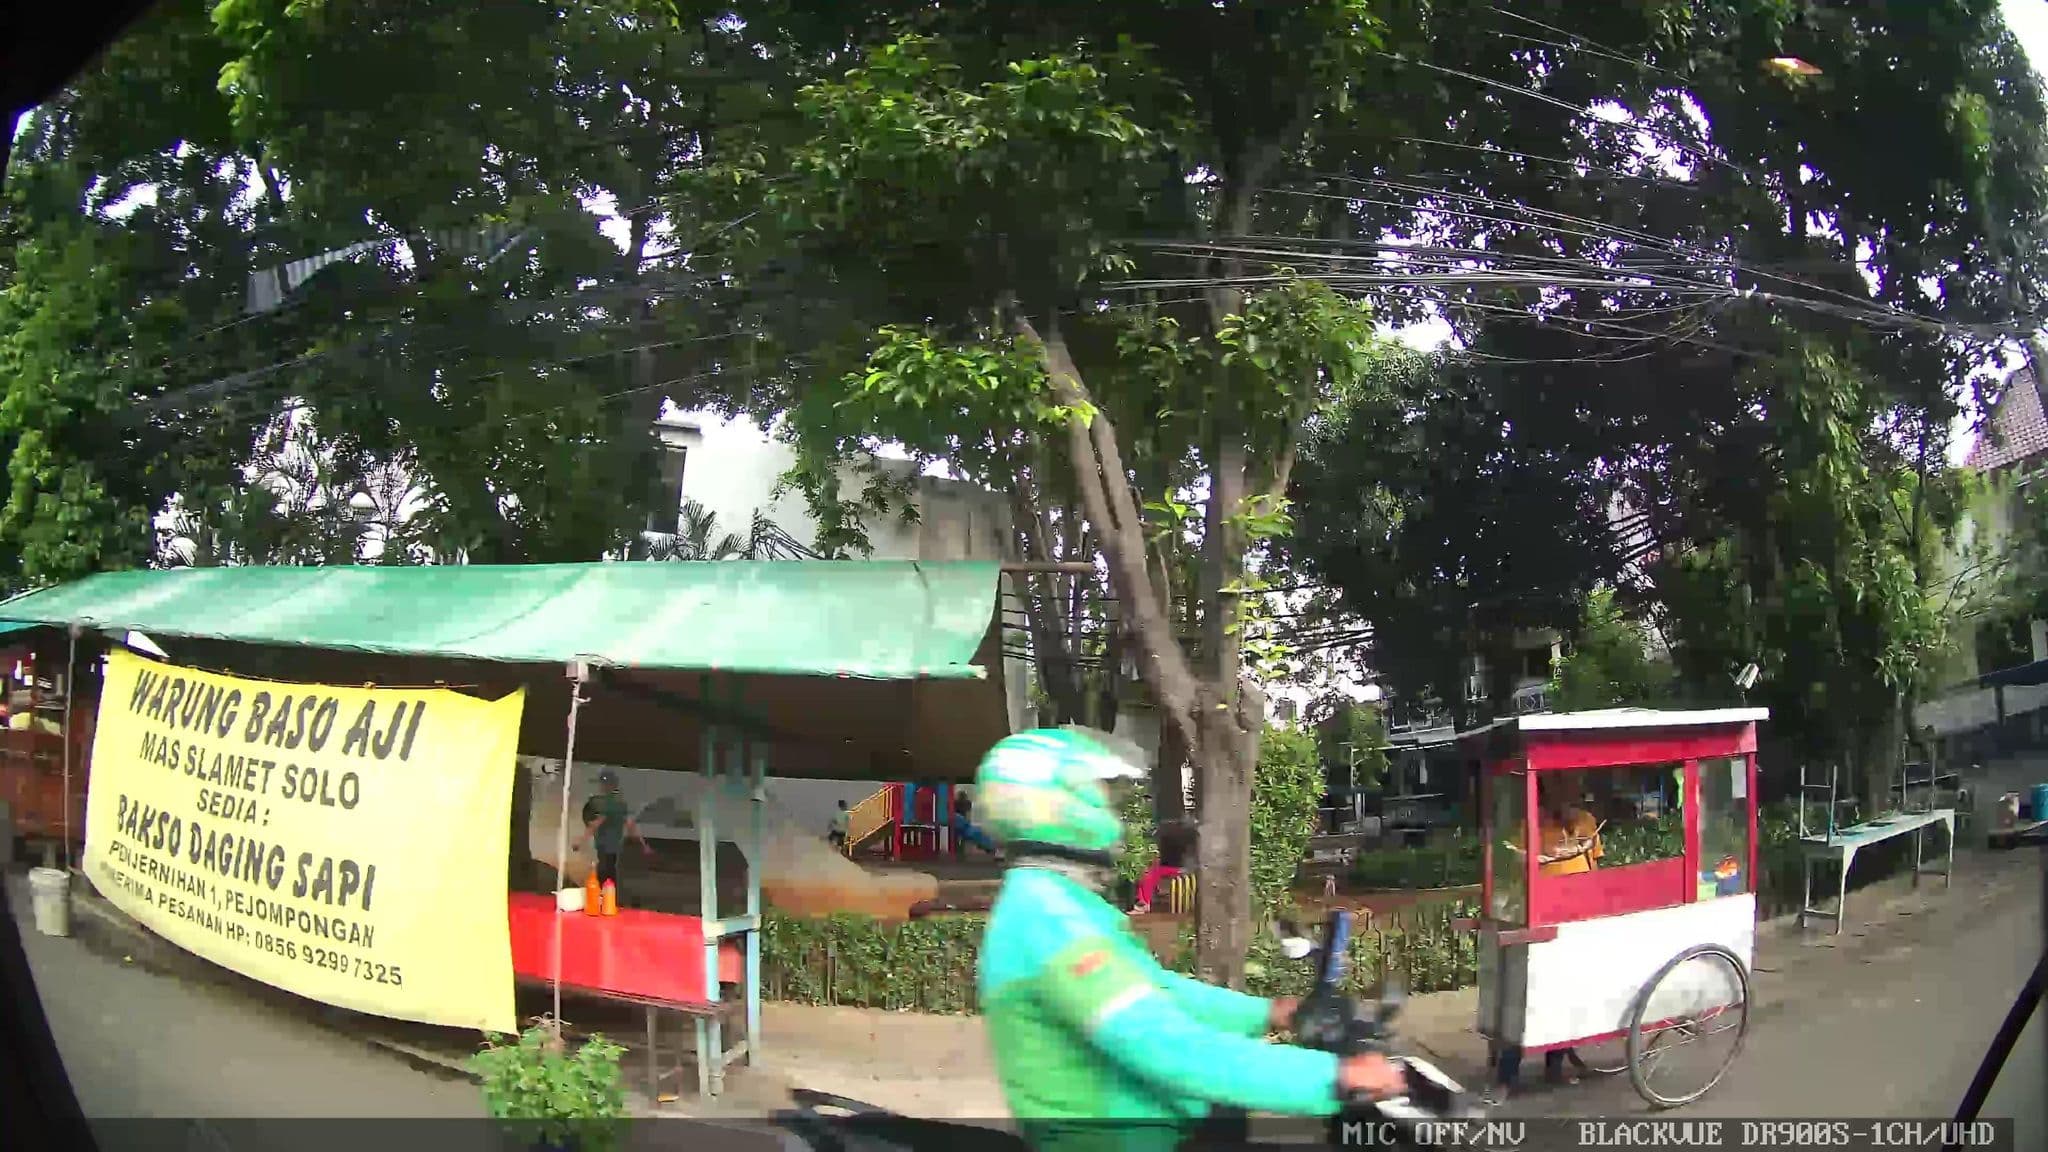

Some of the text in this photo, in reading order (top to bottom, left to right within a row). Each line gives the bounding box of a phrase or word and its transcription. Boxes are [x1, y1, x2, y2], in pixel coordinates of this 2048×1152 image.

[129, 669, 427, 761] WARUNG BASO AJI
[140, 731, 360, 810] MAS SLAMET SOLO
[117, 794, 377, 911] BAKSO DAGING SAPI
[158, 893, 222, 935] PESANAN
[226, 921, 250, 947] HP:
[255, 930, 297, 960] 0856
[302, 944, 349, 973] 9299
[354, 957, 402, 986] 7325
